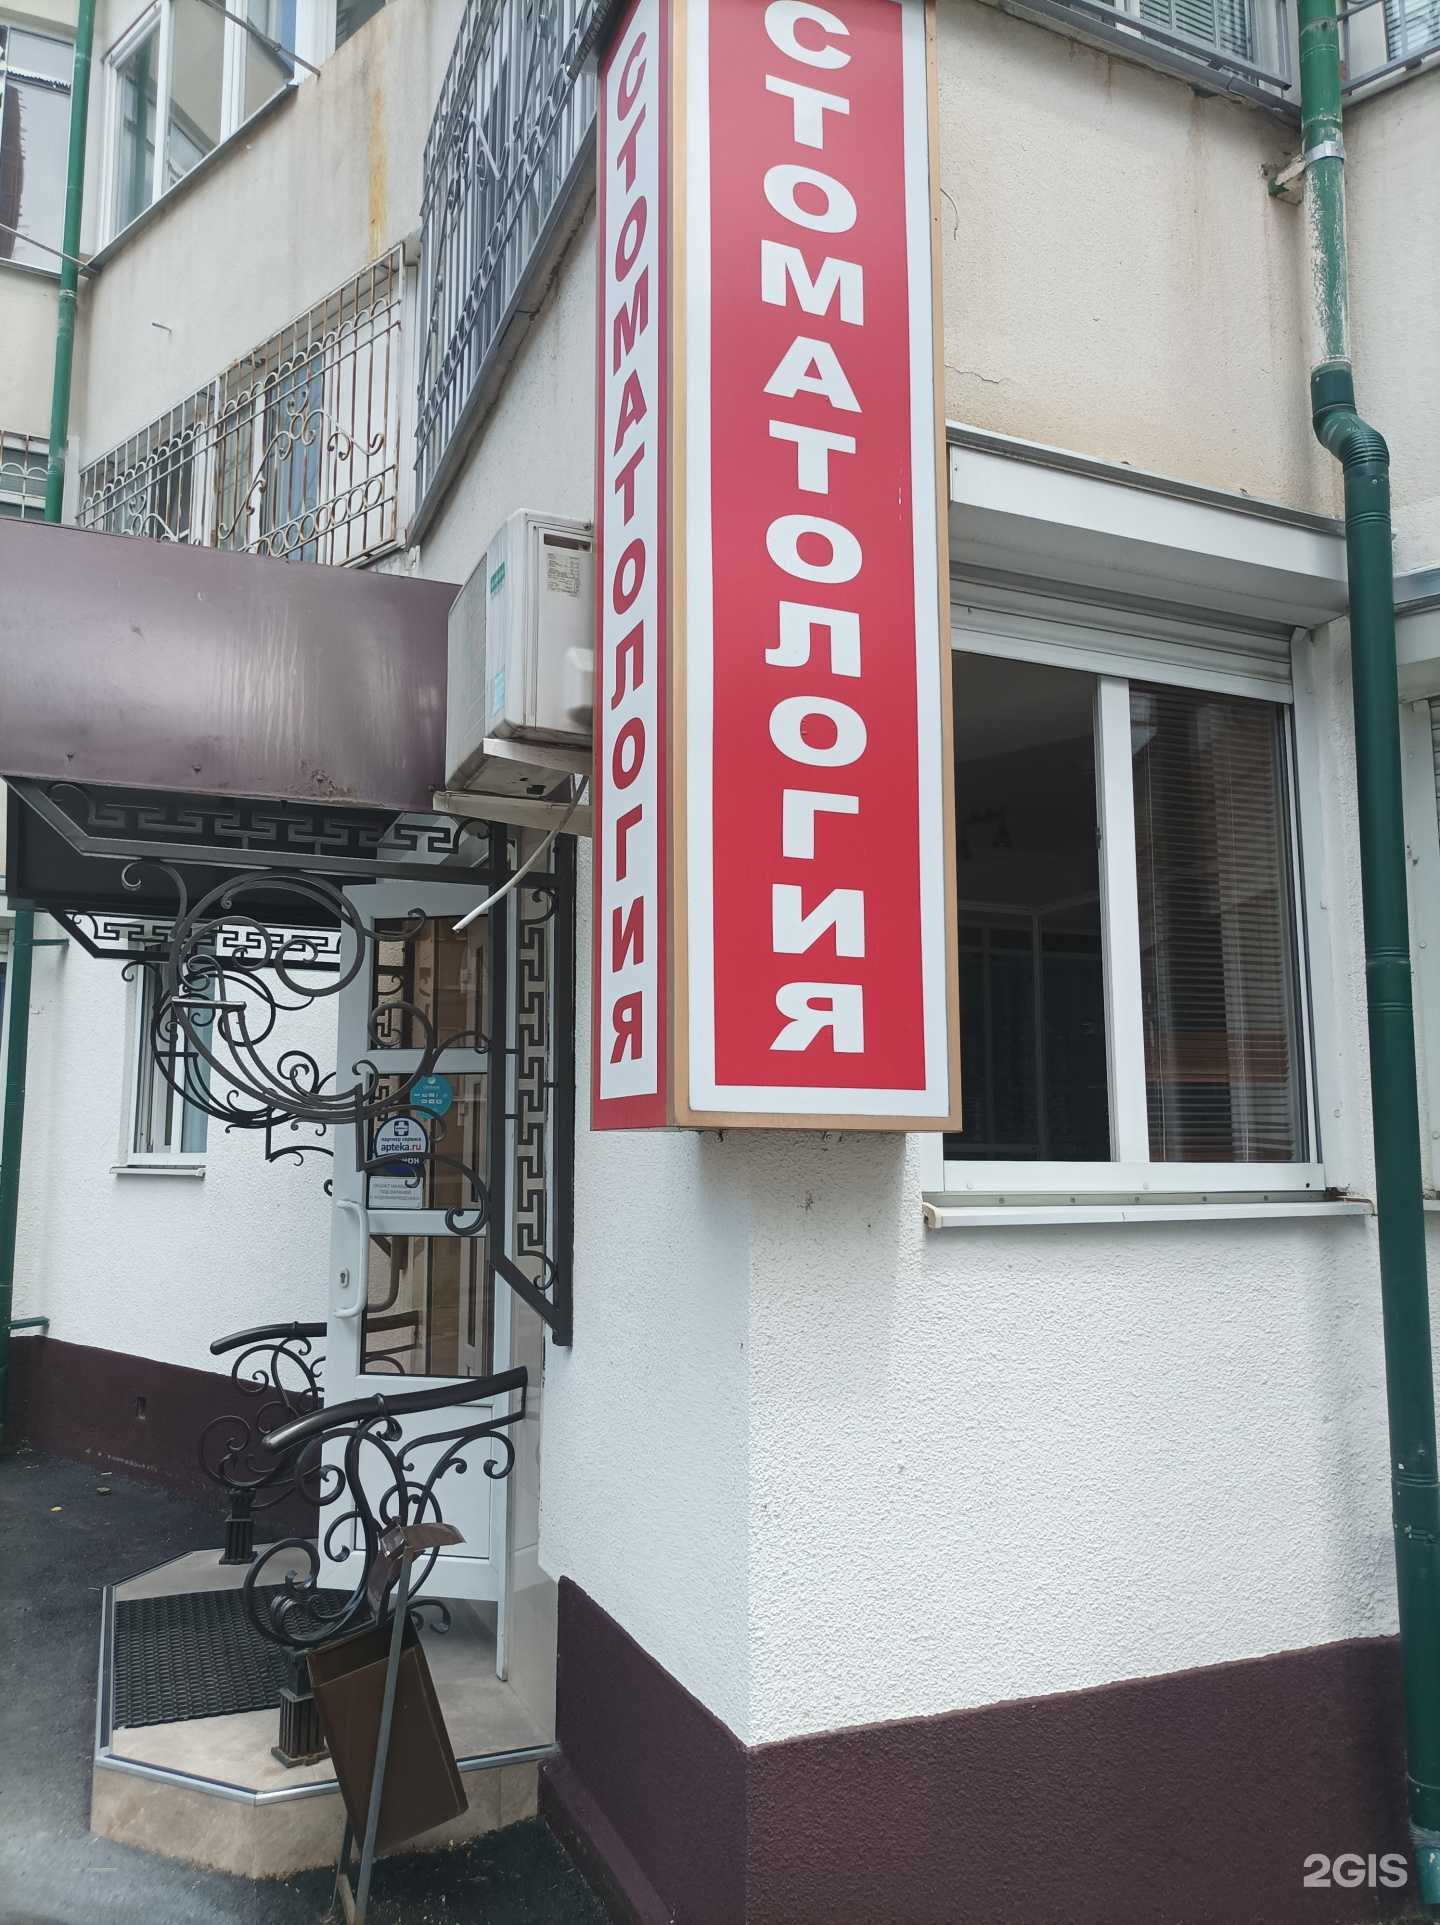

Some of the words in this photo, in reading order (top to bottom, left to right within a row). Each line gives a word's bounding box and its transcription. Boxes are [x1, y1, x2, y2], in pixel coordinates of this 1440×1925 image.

[610, 31, 648, 1064] СТОМАТОЛОГИЯ
[761, 0, 867, 1053] СТОМАТОЛОГИЯ
[381, 1142, 421, 1152] apteka.ru
